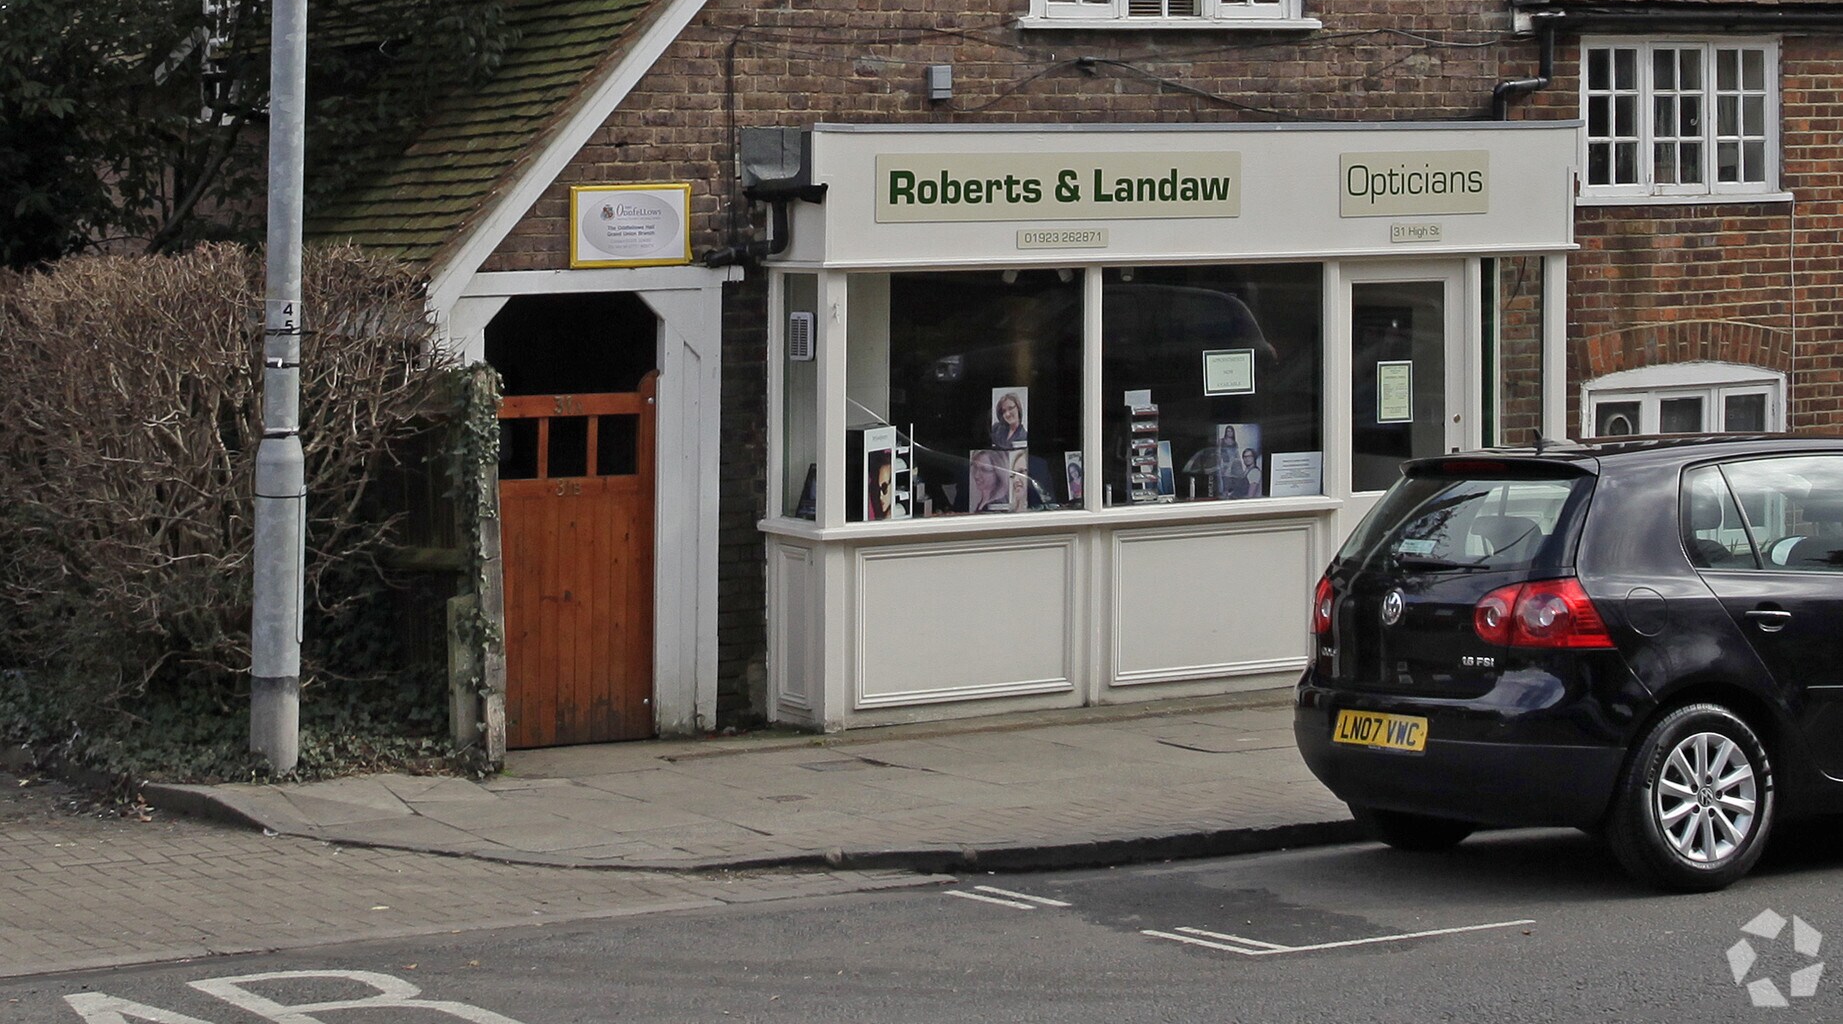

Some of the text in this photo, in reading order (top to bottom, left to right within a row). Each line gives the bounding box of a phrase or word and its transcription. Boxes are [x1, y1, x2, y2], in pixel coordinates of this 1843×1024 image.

[889, 168, 1231, 204] Roberts & Landaw
[1347, 164, 1483, 204] Opticians
[1024, 231, 1102, 243] 01923 262871
[1393, 227, 1405, 237] 31
[1408, 226, 1428, 238] High
[283, 303, 293, 316] 4
[285, 320, 293, 333] 5
[1476, 656, 1495, 667] FSI
[1340, 715, 1420, 747] LN07 VWC
